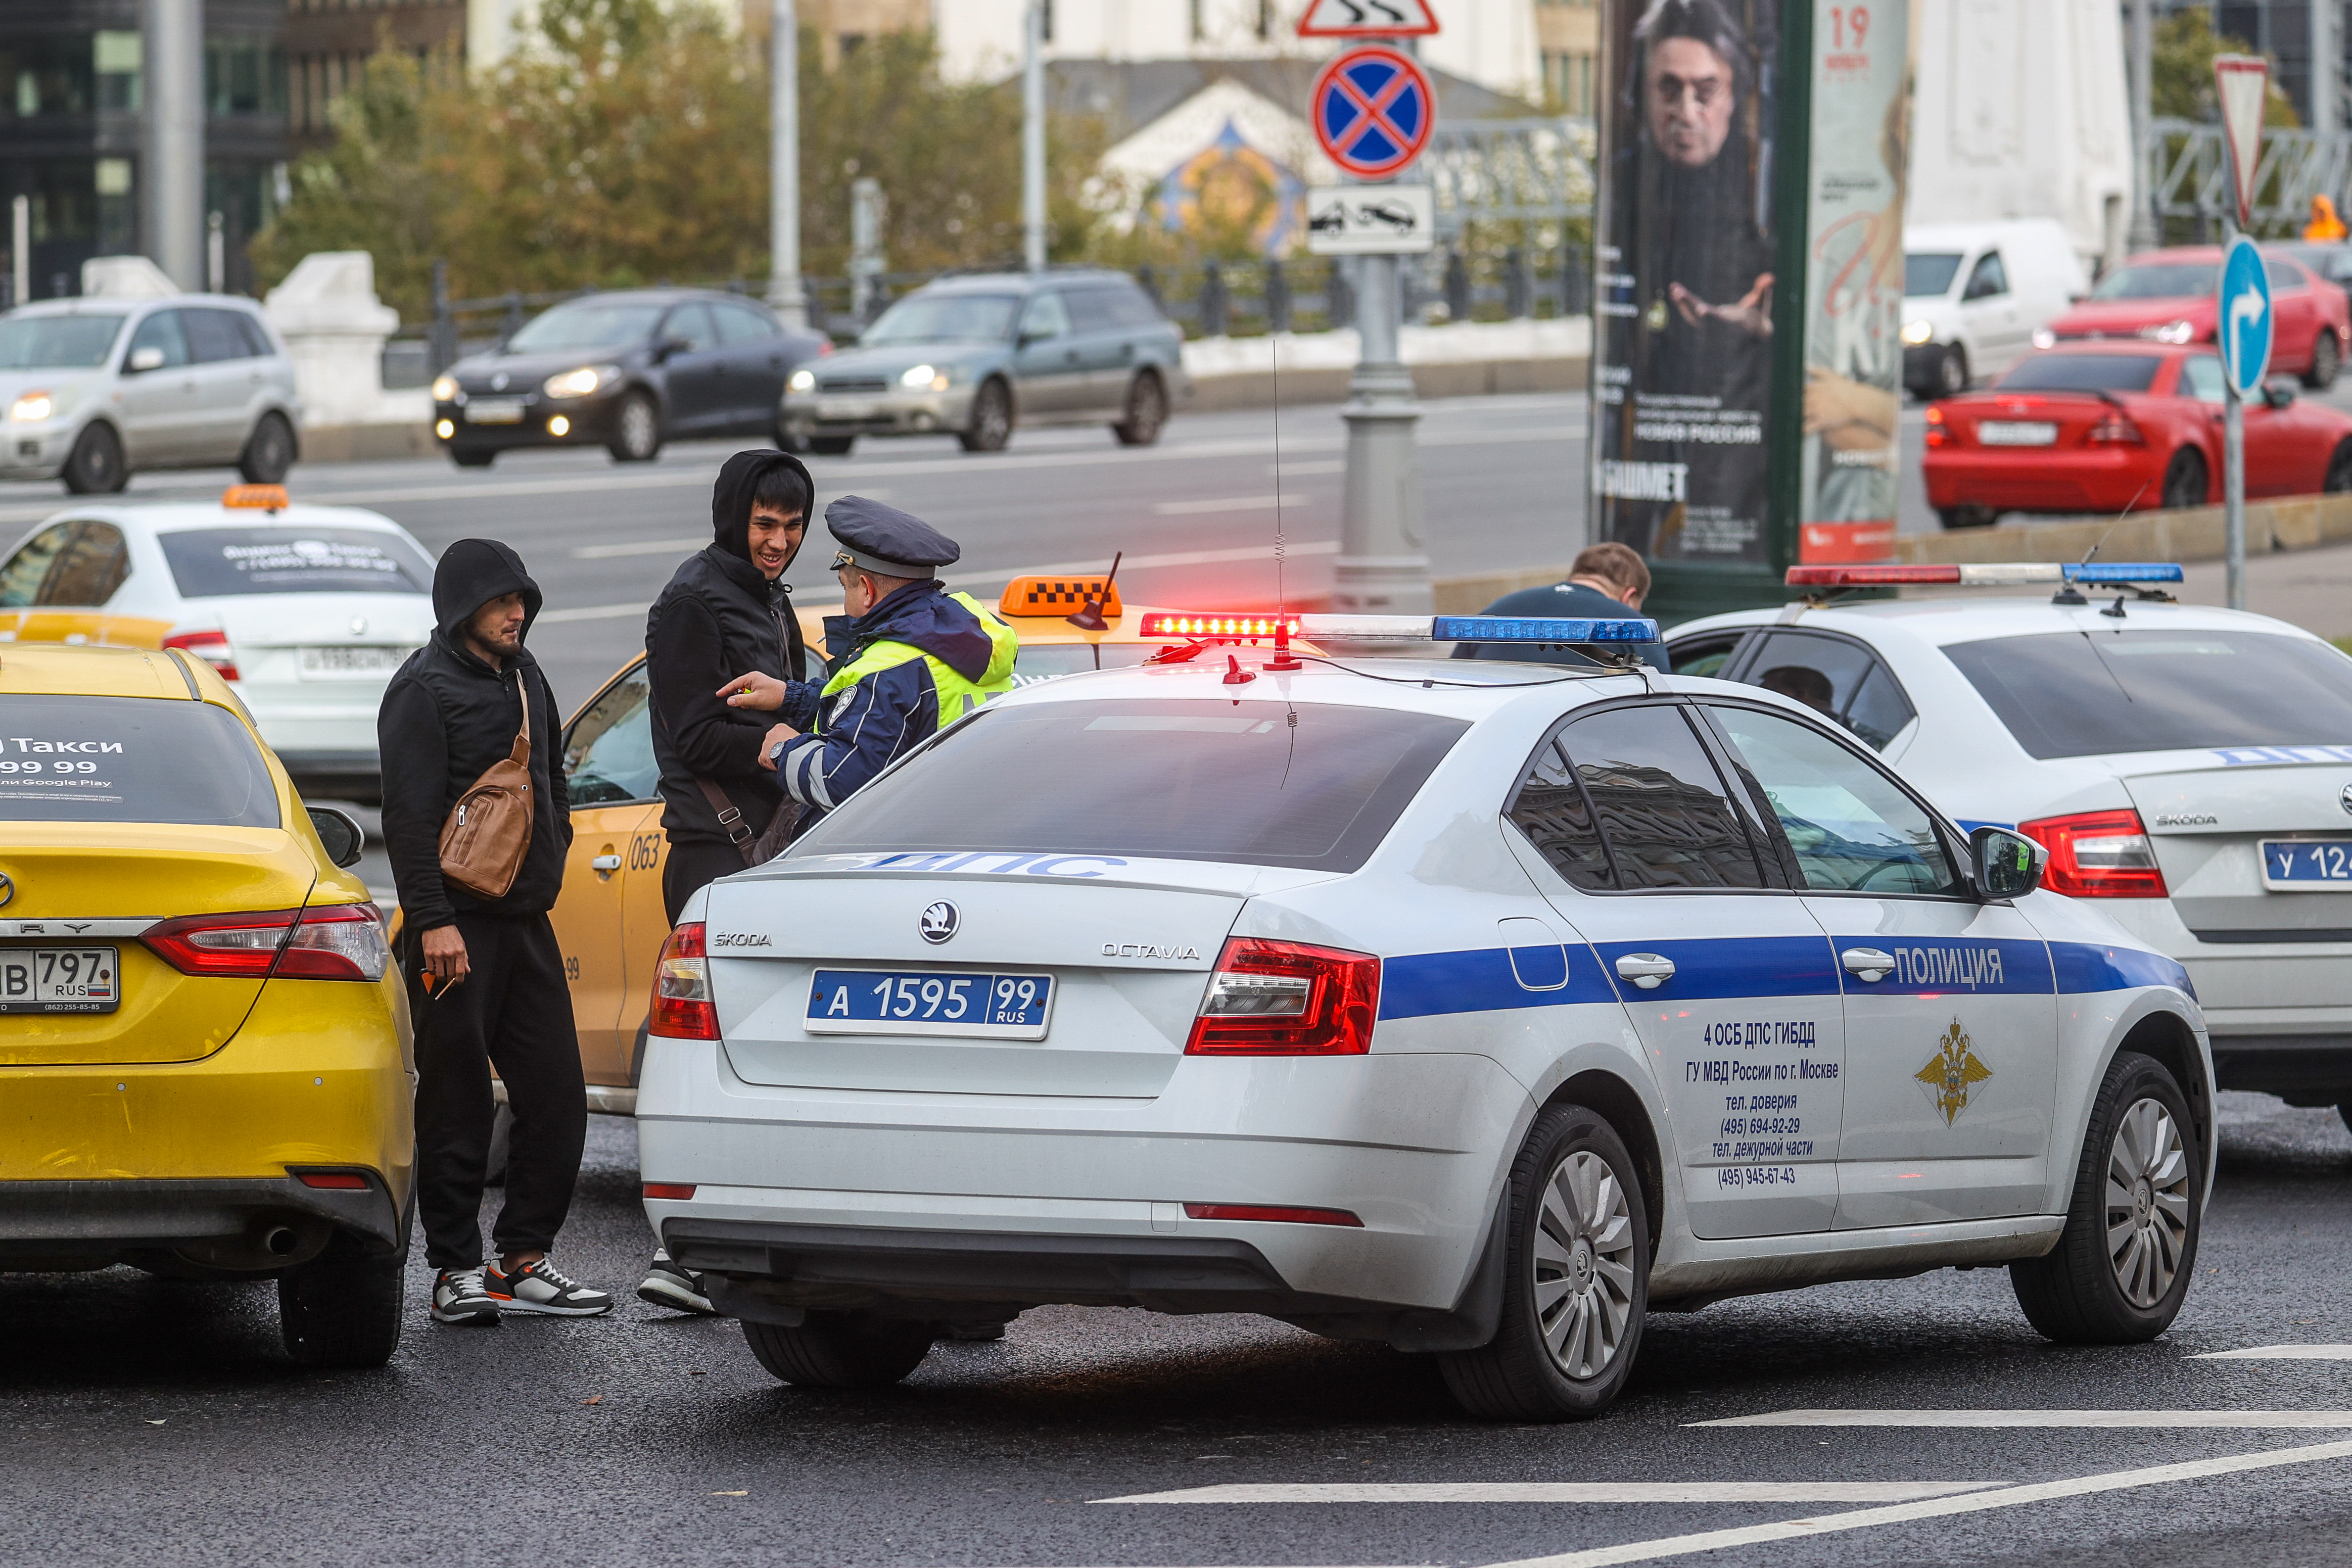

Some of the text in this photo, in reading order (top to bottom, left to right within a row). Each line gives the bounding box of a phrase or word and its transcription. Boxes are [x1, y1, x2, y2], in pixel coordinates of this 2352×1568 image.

[1828, 5, 1870, 50] 19
[10, 738, 123, 753] Такси
[54, 761, 97, 774] 99
[632, 834, 660, 871] 063
[2279, 846, 2352, 878] У 12
[847, 852, 1127, 878] ДПС
[714, 931, 772, 946] ŠKODA
[1102, 943, 1200, 960] OCTAVIA
[0, 953, 101, 995] В 797
[1894, 947, 2004, 990] ПОЛИЦИЯ
[56, 985, 86, 996] RUS
[827, 977, 1037, 1020] А 1595 99
[996, 1011, 1026, 1023] RUS
[1704, 1021, 1815, 1050] 4 ОСБ ДПС ГИБДД
[1686, 1059, 1839, 1085] ГУ МВД России по г. Москве
[1726, 1095, 1797, 1114] тел. доверия
[1721, 1117, 1800, 1138] (495) 694-92-29
[1713, 1137, 1813, 1161] тел. дежурной части
[1718, 1167, 1795, 1190] (495) 945-67-43
